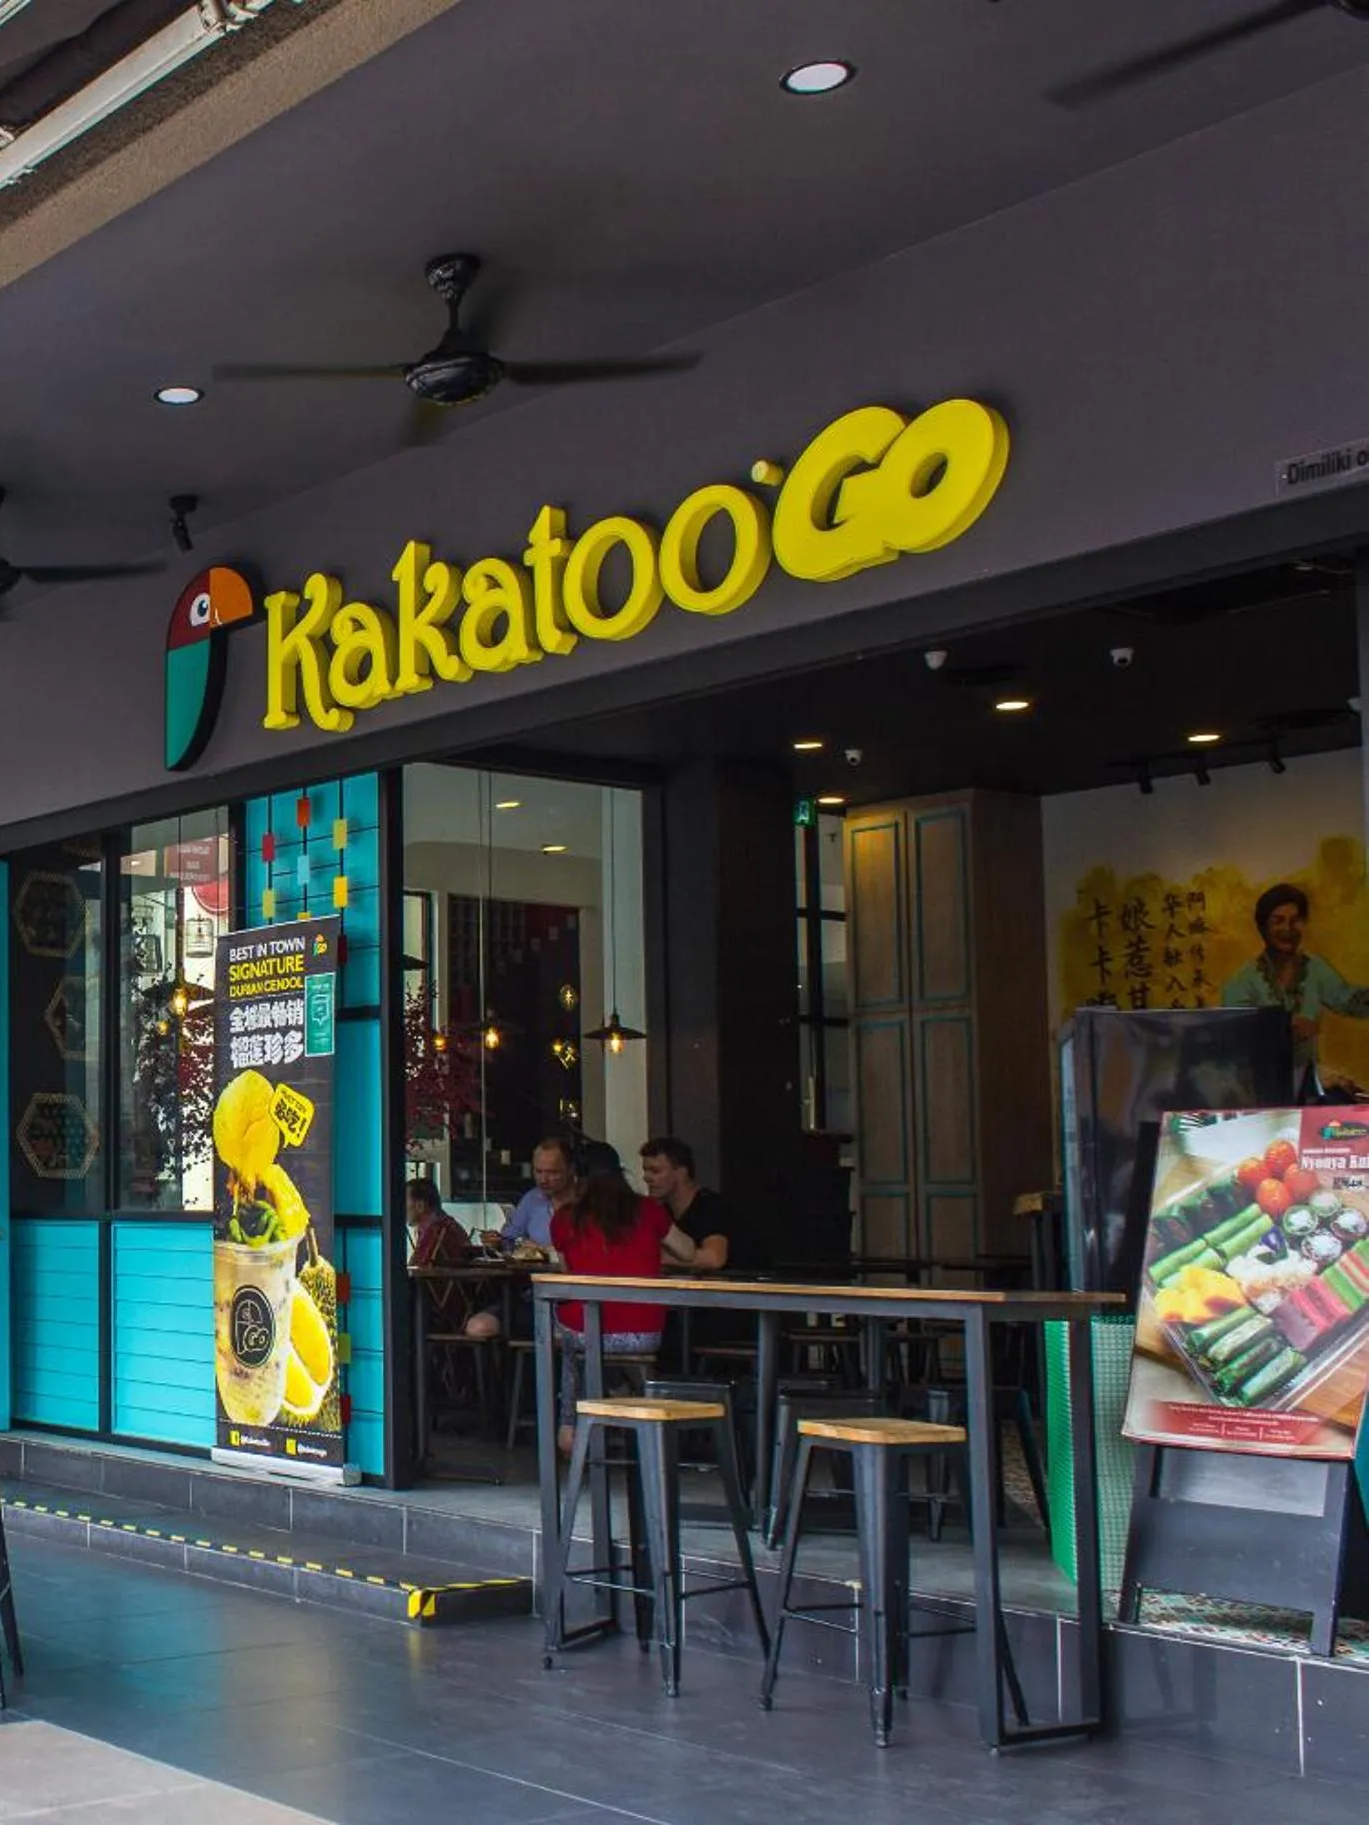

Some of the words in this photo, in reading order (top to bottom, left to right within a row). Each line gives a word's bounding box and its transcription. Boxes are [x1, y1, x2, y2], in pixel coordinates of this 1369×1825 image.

[1288, 448, 1351, 484] Dimiliki
[229, 945, 255, 962] BEST
[256, 943, 268, 957] IN
[269, 936, 306, 955] TOWN
[229, 954, 304, 983] SIGNATURE
[229, 982, 264, 998] DURIAN
[264, 976, 304, 992] CENDOL
